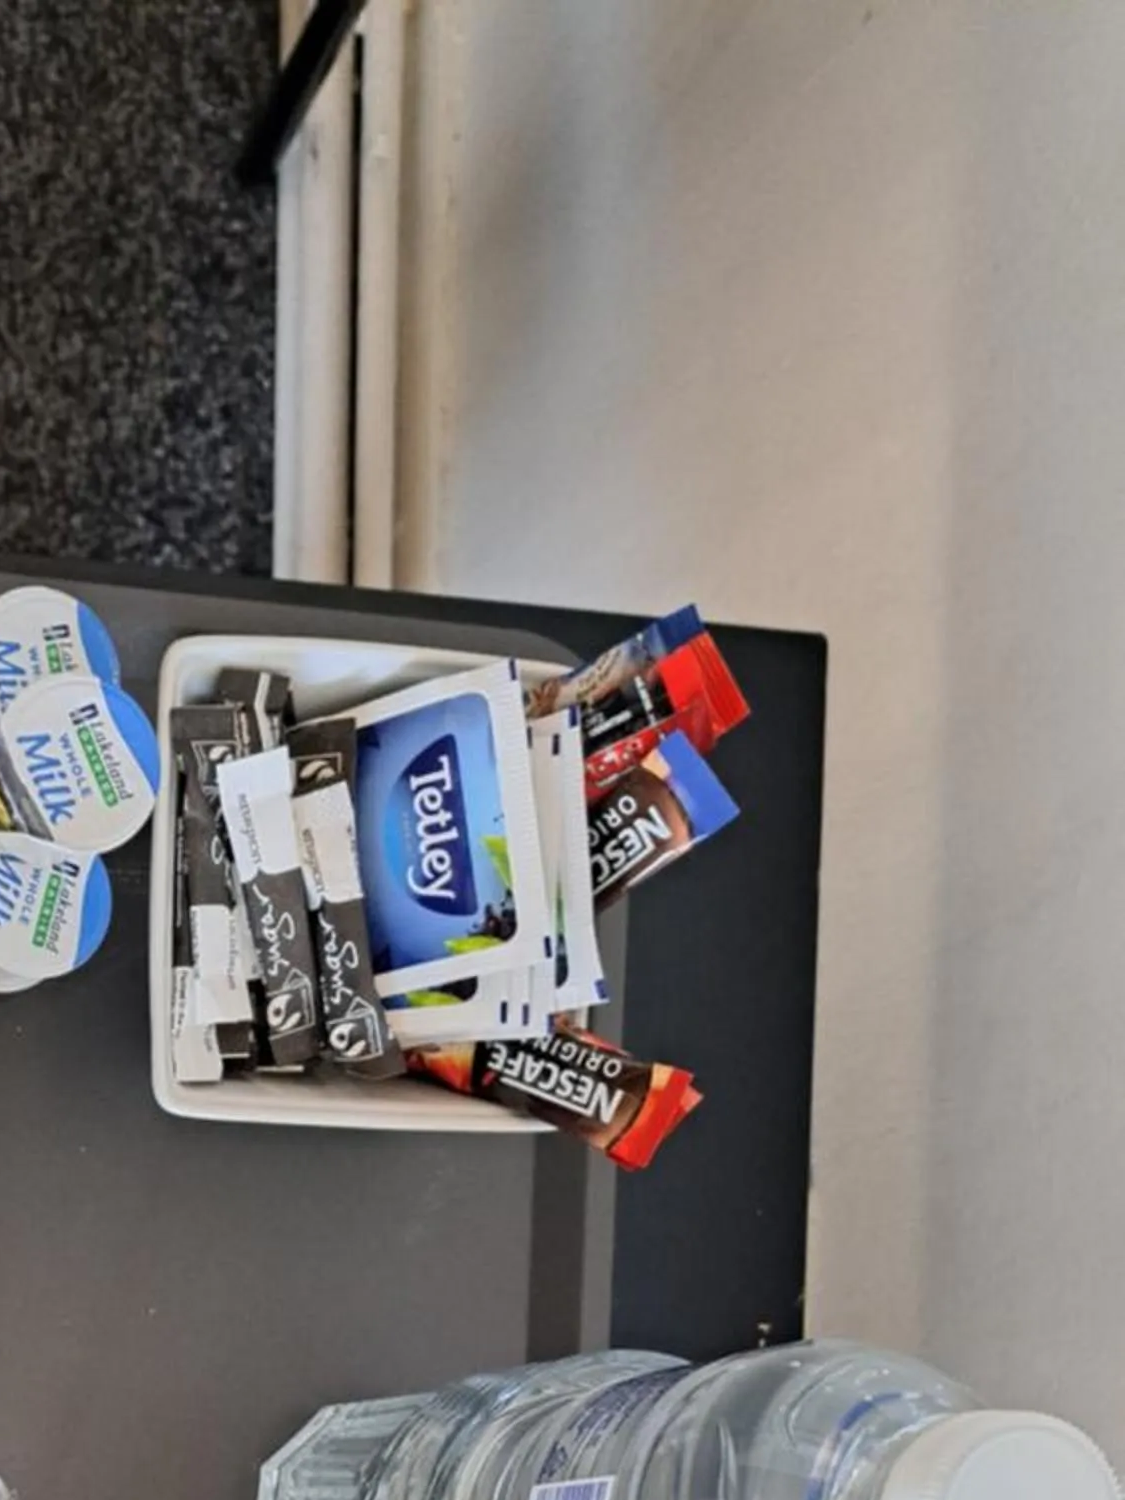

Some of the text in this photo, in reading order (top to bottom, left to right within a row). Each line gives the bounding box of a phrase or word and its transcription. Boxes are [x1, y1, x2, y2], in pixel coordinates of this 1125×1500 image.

[16, 733, 76, 826] Milk
[59, 732, 94, 797] WHOLE
[90, 721, 134, 801] Lakeland
[407, 754, 460, 900] Tetley
[591, 806, 673, 884] NESC
[19, 868, 42, 926] WHOLE
[46, 876, 75, 955] Lakeland
[252, 884, 296, 976] sugar
[318, 911, 359, 1005] sugar
[530, 1036, 623, 1078] ORIGIN
